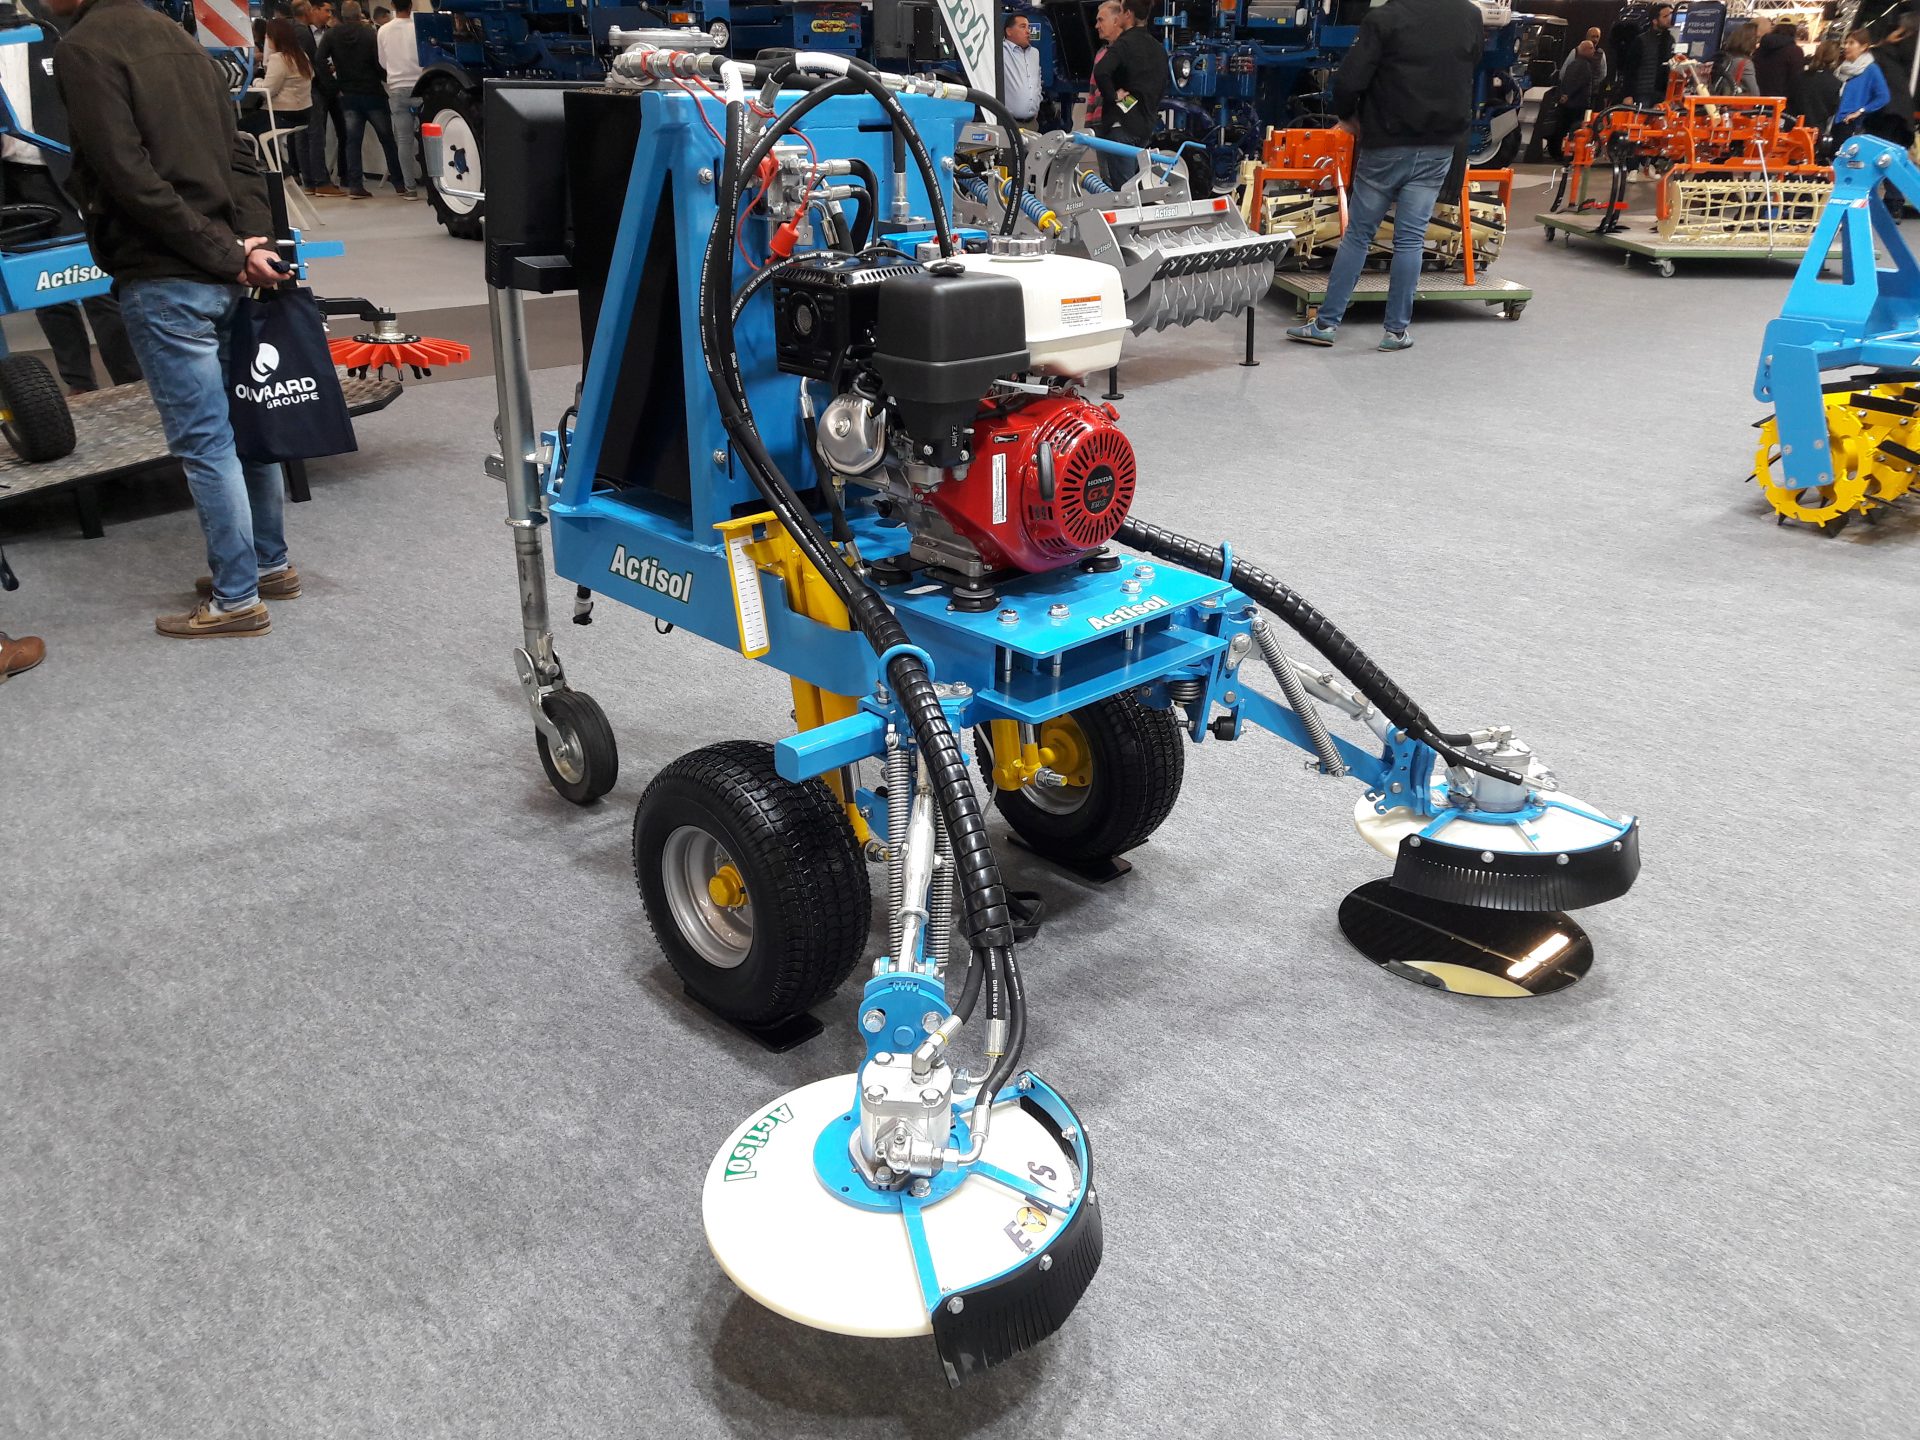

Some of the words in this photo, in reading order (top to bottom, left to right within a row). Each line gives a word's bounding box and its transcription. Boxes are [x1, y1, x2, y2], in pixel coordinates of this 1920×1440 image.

[1154, 206, 1178, 218] Actisol
[1093, 242, 1112, 256] Actisol
[36, 264, 109, 291] Actiso
[266, 392, 320, 409] GROUPE
[1088, 475, 1114, 487] HONDA
[1088, 484, 1112, 500] GX
[608, 544, 694, 604] Actisol
[1086, 594, 1171, 631] Actisol
[992, 992, 998, 1002] EN
[724, 1102, 794, 1182] Actisol
